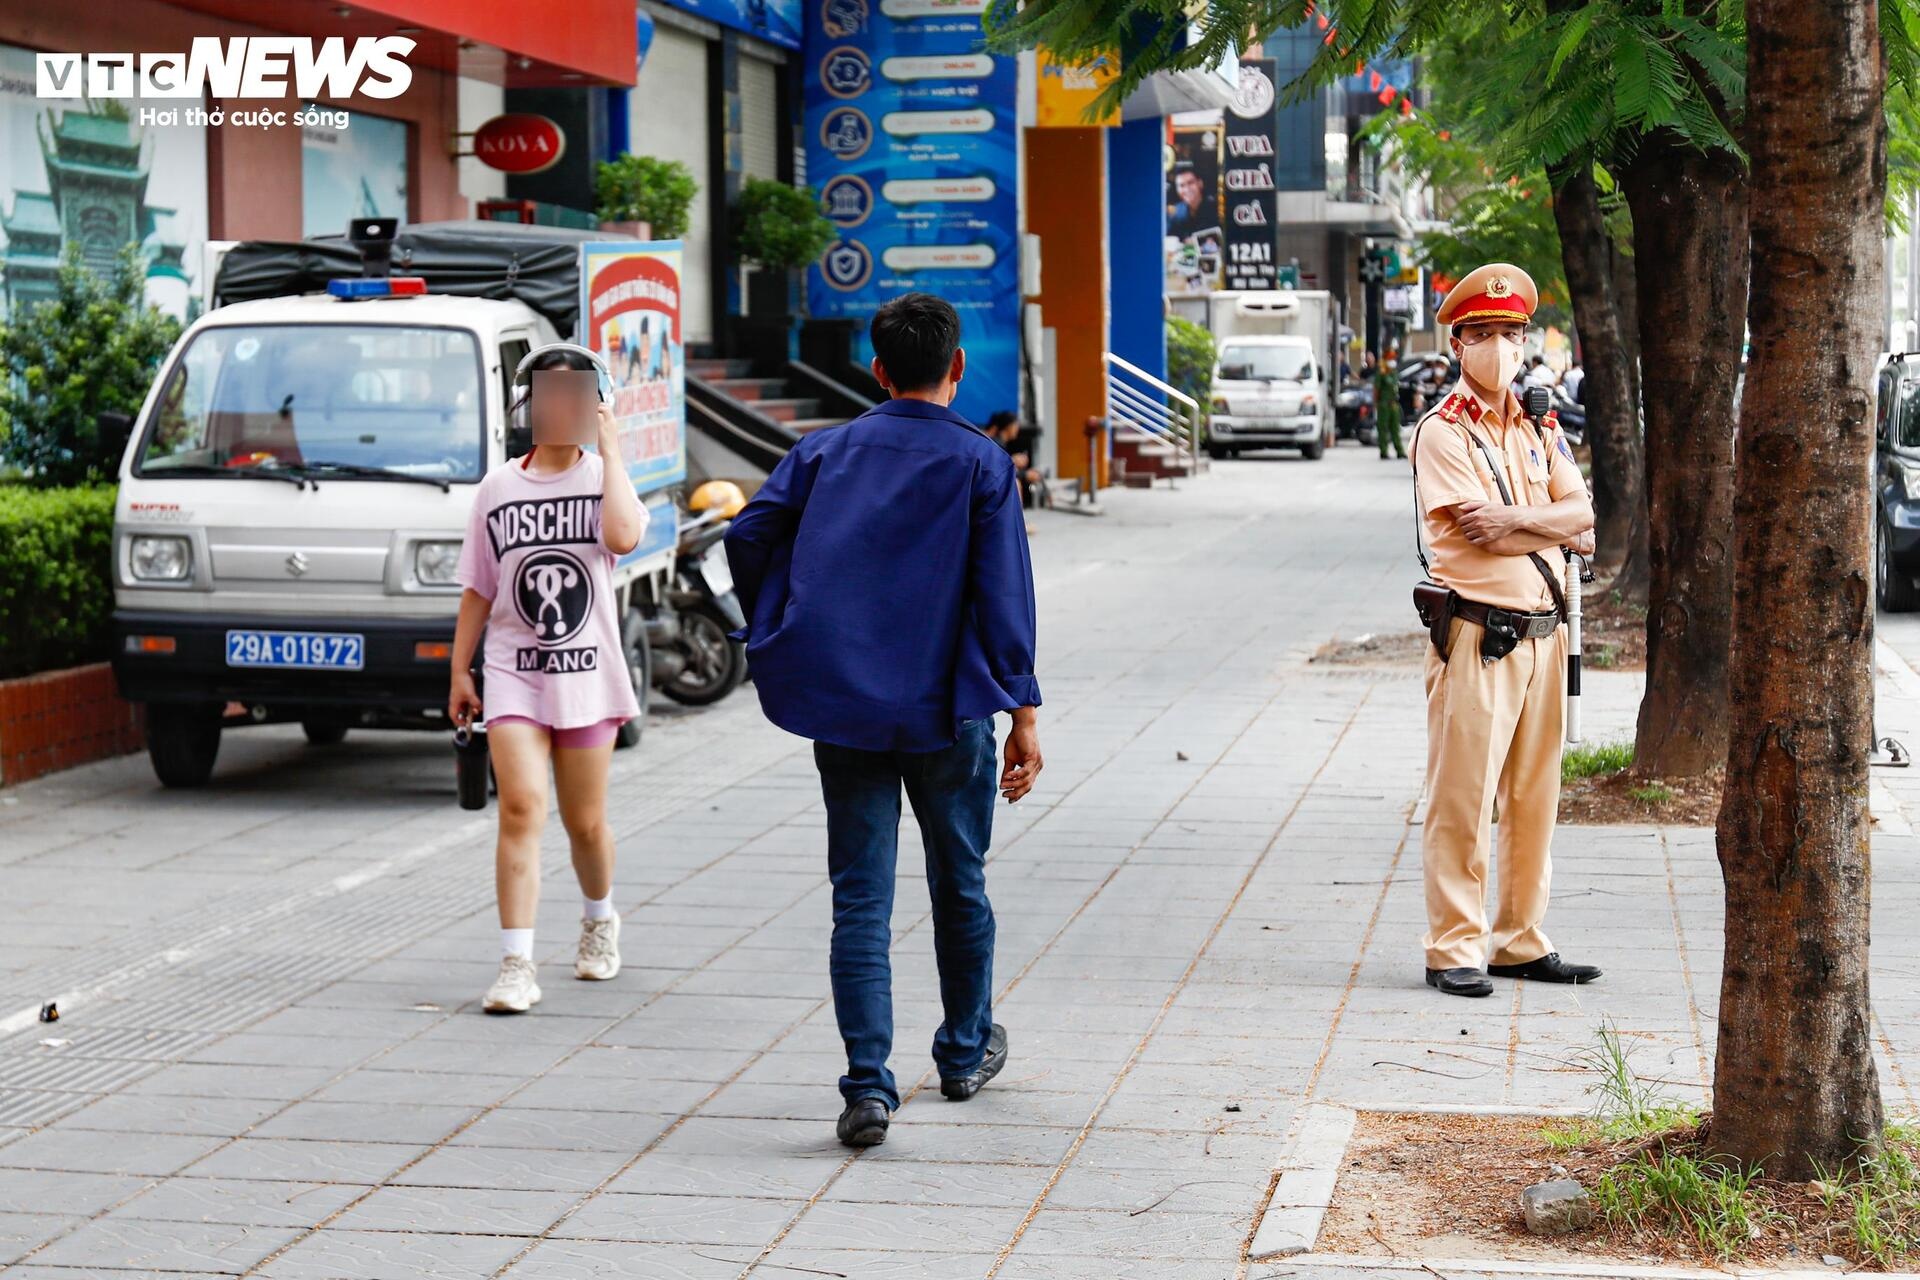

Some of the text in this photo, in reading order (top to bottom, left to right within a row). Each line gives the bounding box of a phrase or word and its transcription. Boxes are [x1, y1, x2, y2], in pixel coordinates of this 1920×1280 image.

[482, 134, 550, 153] KOVA
[1229, 242, 1271, 263] 12A1
[488, 498, 601, 554] MOSCHIN
